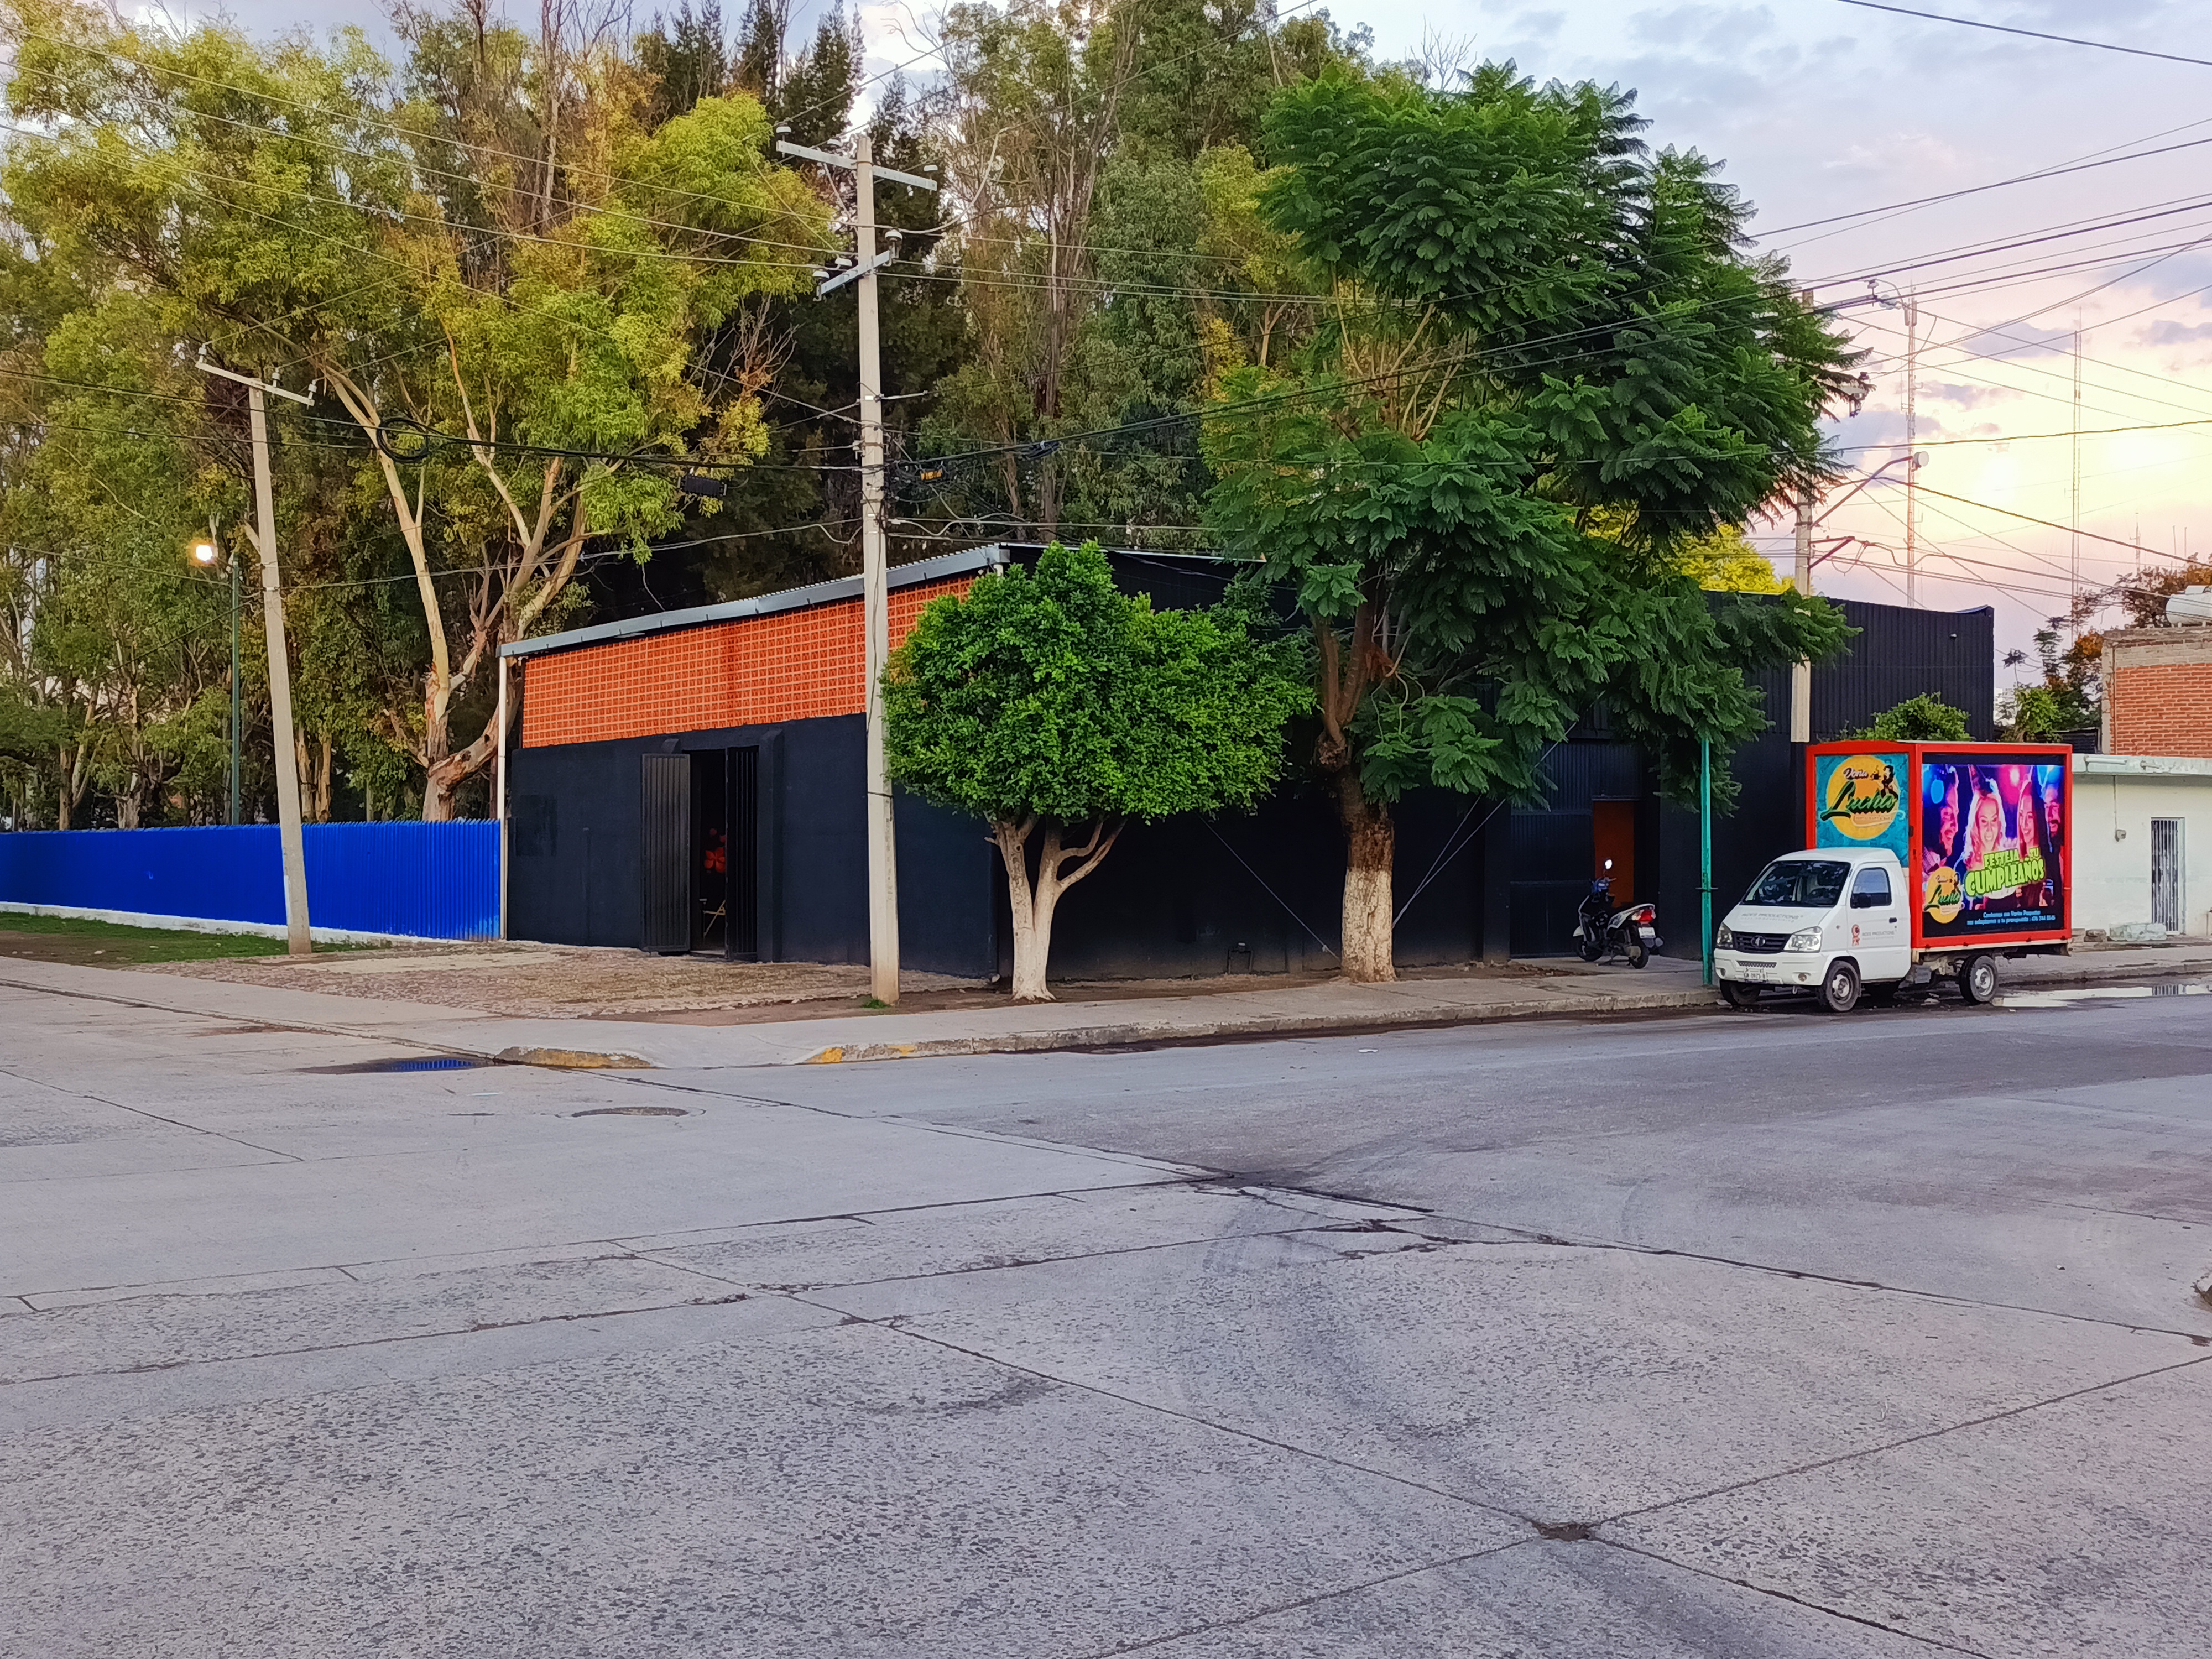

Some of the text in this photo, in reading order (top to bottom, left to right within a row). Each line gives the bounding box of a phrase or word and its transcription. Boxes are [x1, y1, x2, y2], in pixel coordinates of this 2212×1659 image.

[1820, 780, 1898, 821] Lucha
[1984, 849, 2020, 868] FESTEJA
[1964, 856, 2045, 897] CUMPLEAÑOS
[1923, 884, 1961, 911] Lucha
